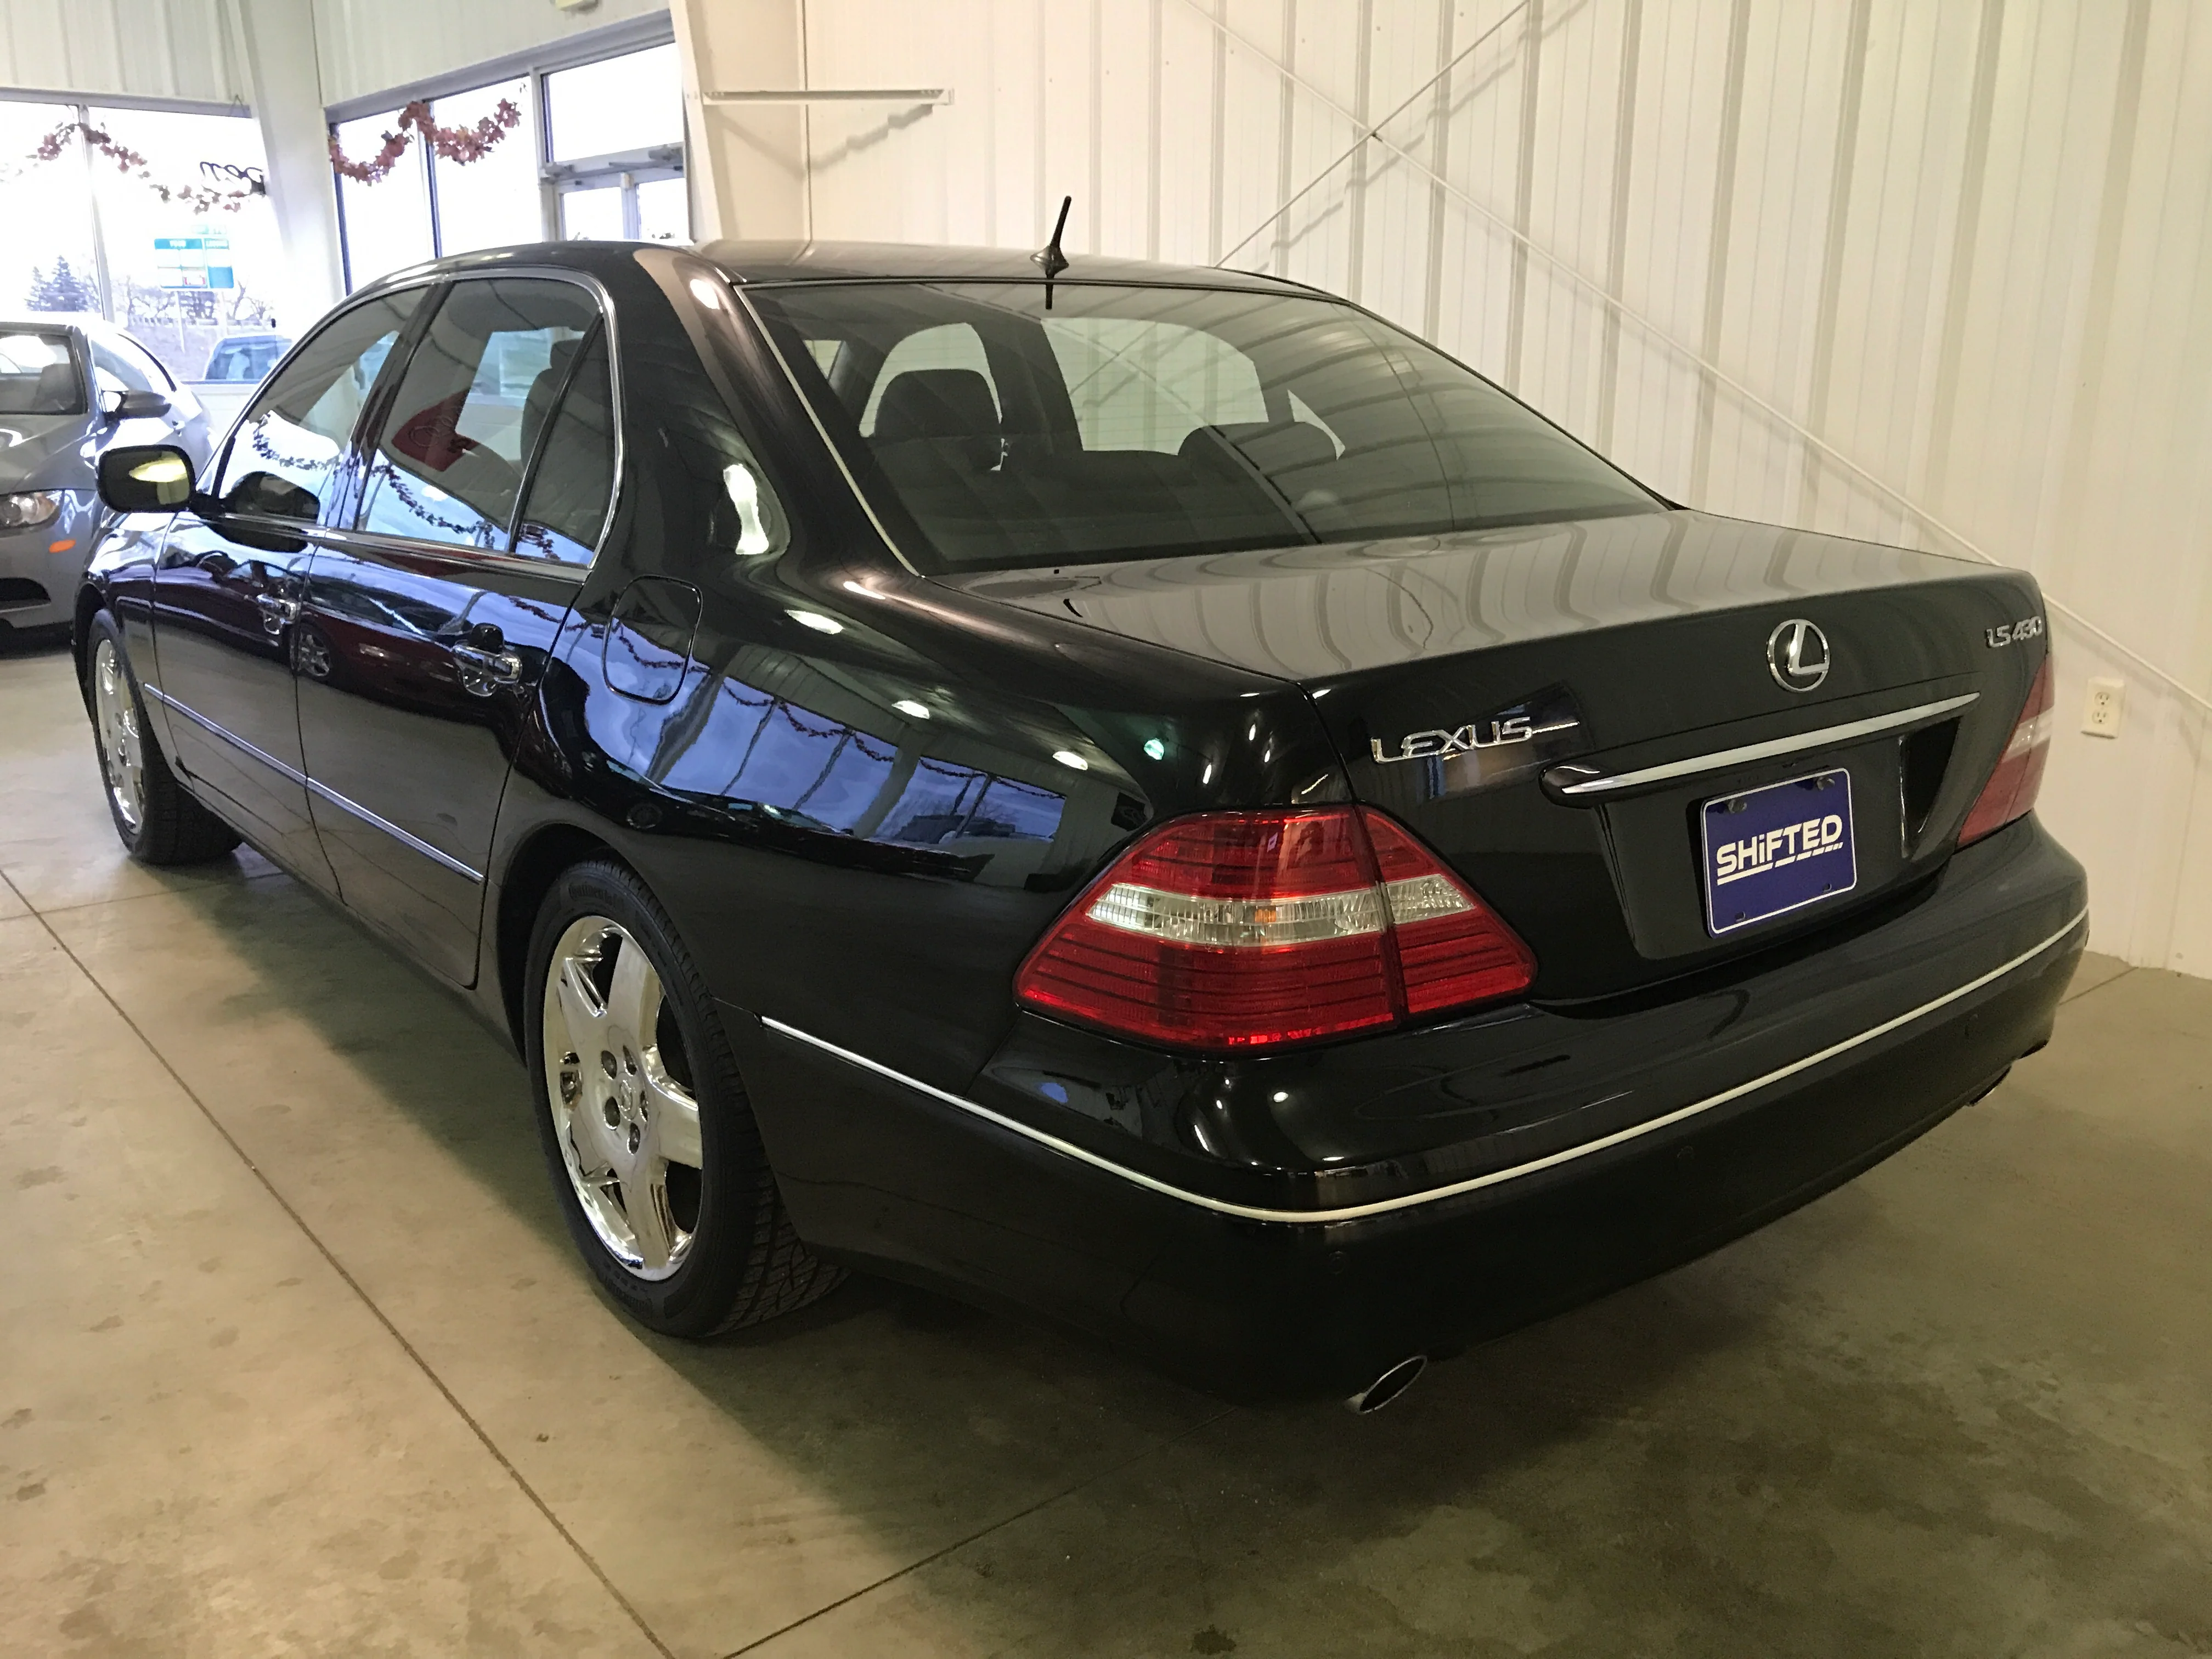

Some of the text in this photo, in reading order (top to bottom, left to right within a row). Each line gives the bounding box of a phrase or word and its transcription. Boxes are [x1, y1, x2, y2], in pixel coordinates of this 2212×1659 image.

[1985, 616, 2042, 648] LS 430
[1370, 716, 1532, 764] LEXUS
